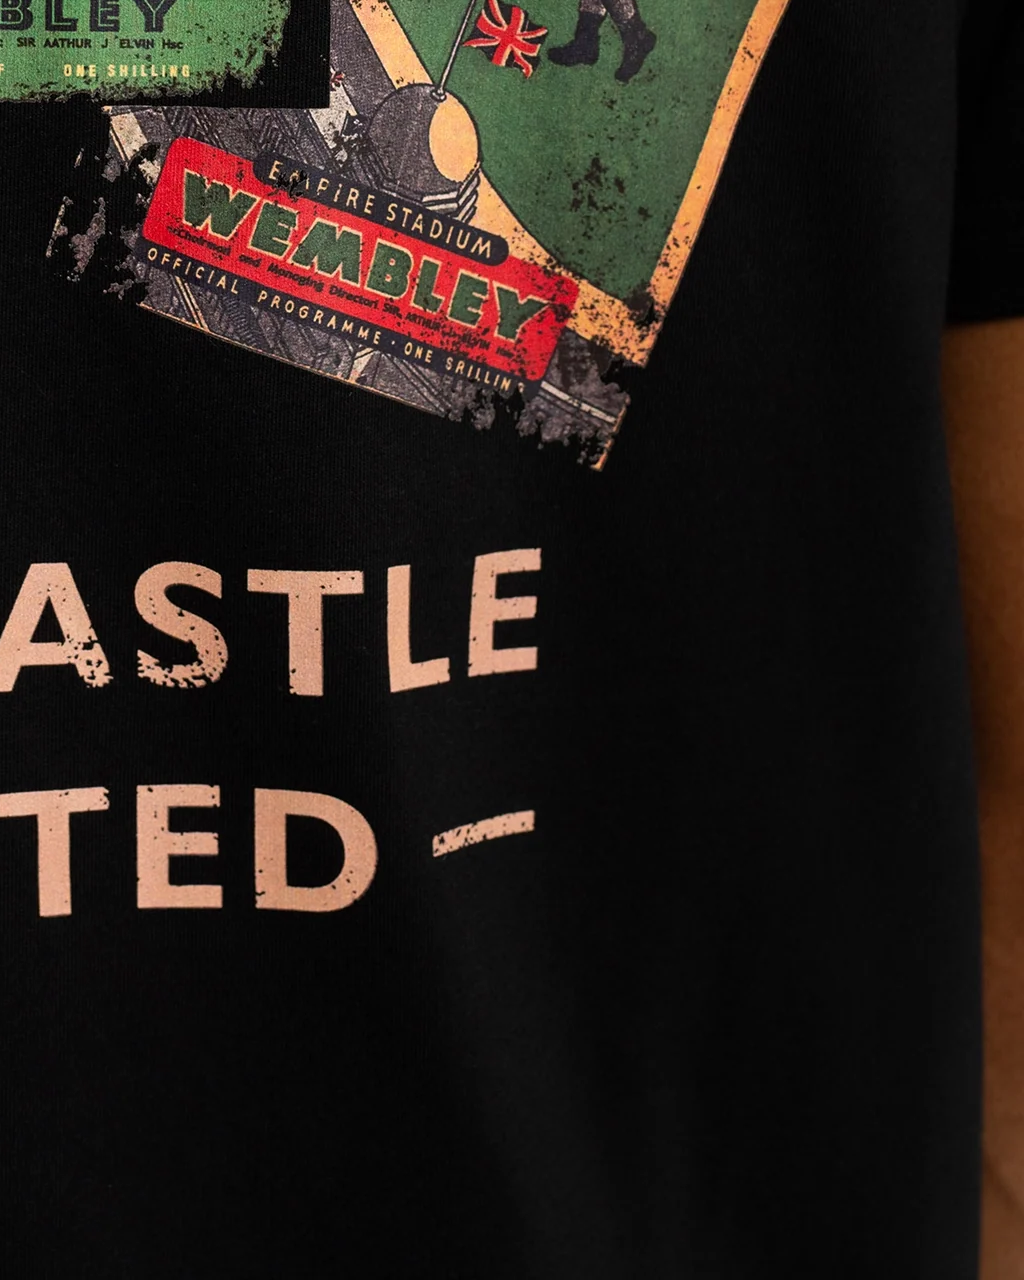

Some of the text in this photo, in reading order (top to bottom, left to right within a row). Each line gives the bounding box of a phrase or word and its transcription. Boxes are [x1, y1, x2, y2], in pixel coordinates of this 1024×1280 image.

[17, 38, 36, 48] SIR
[120, 38, 155, 49] ELVIN
[63, 63, 97, 78] ONE
[107, 63, 191, 78] SHILLING
[181, 168, 554, 341] WEMBLEY
[386, 203, 492, 259] STADIUM
[147, 247, 238, 295] OFFICIAL
[257, 290, 382, 344] PROGRAMME
[404, 341, 433, 363] ONE
